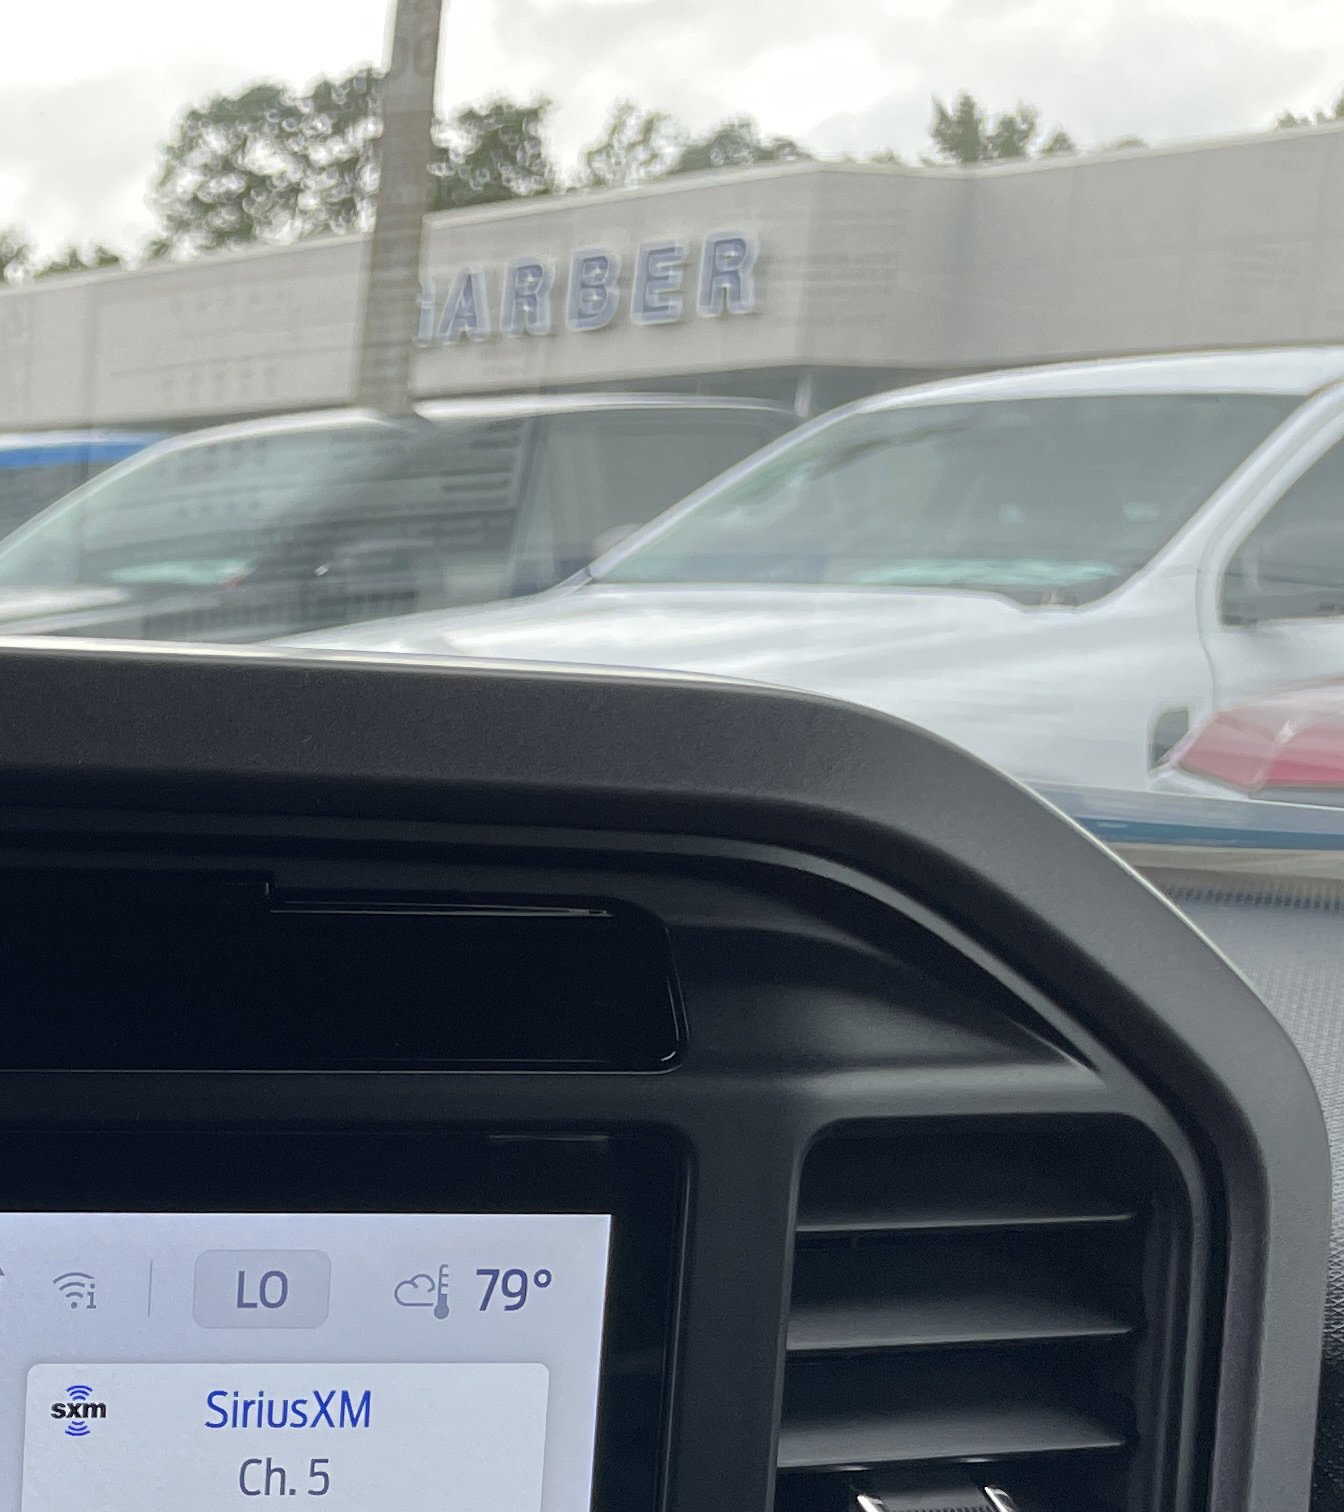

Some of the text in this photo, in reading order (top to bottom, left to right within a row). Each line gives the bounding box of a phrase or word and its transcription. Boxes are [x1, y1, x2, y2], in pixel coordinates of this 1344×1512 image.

[415, 228, 759, 348] ARBER
[237, 1271, 288, 1308] LO
[477, 1269, 551, 1311] 79°
[51, 1401, 107, 1419] sxm
[205, 1391, 371, 1428] SiriusXM
[240, 1458, 329, 1495] Ch. 5
